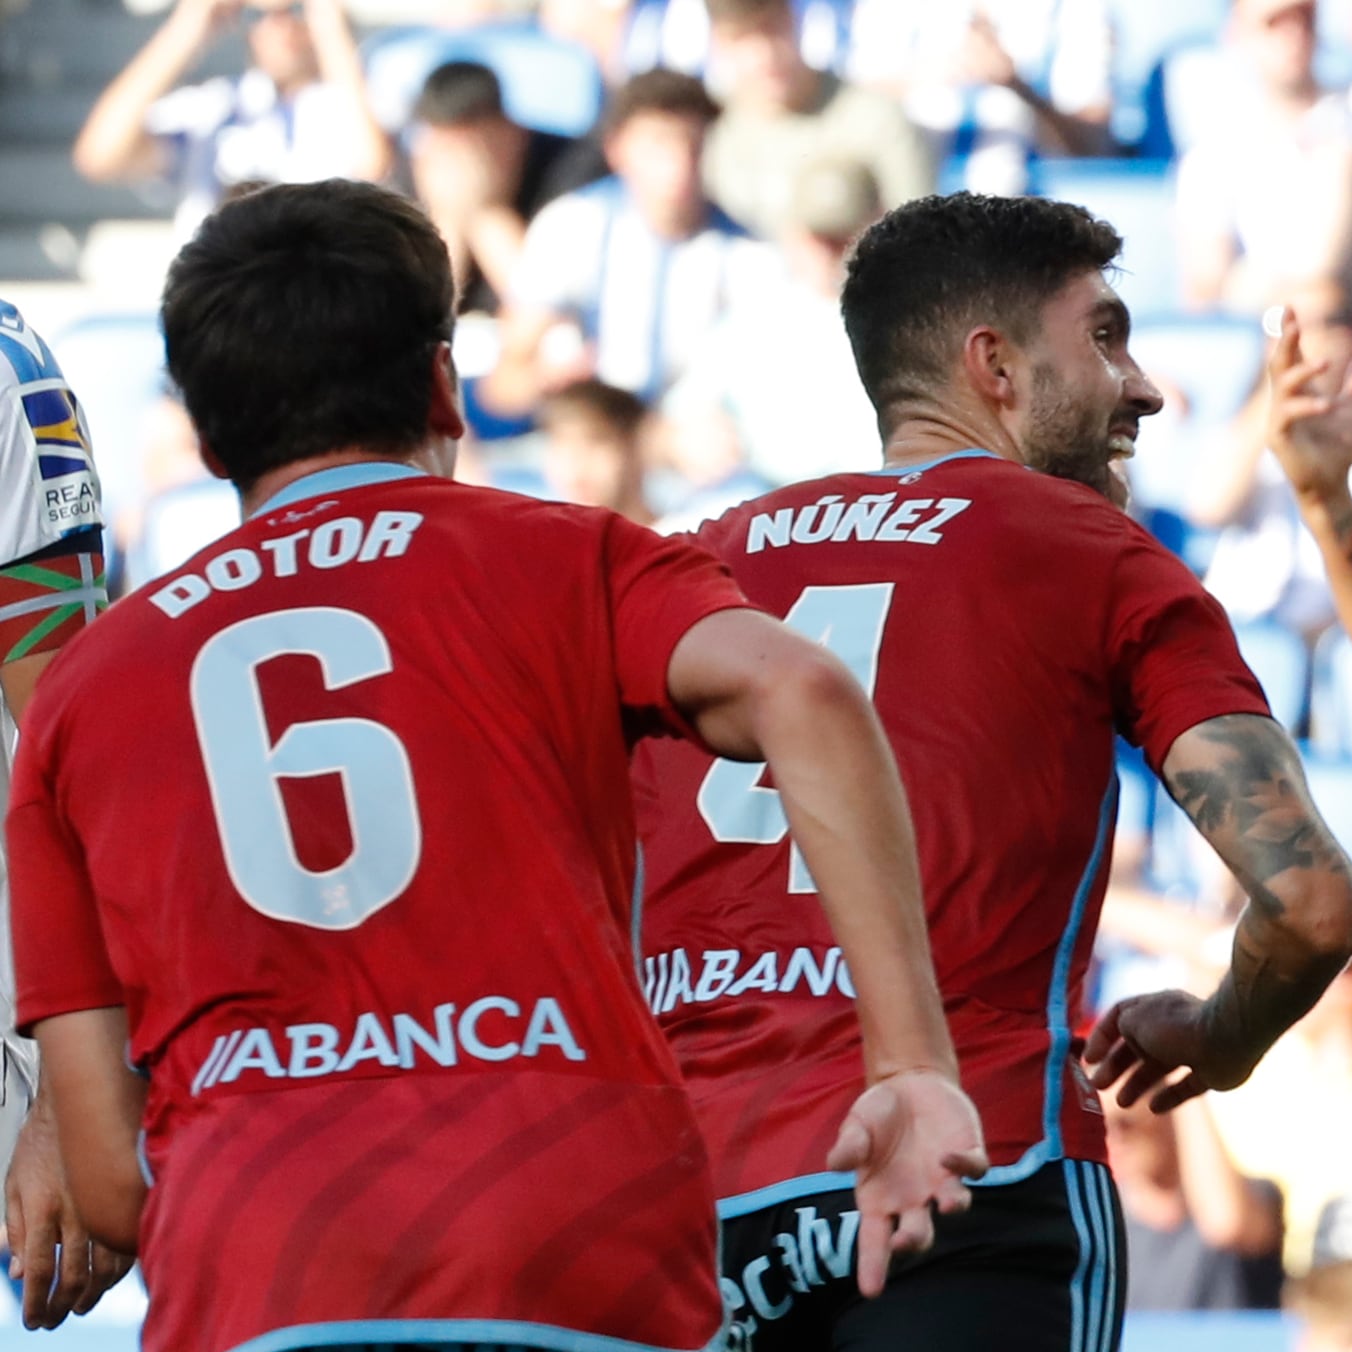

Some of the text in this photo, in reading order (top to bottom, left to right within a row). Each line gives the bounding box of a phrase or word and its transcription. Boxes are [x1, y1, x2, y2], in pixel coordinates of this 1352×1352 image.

[44, 481, 95, 507] REA
[746, 492, 972, 553] NÚÑEZ
[149, 511, 424, 618] DOTOR
[191, 606, 421, 930] 6
[661, 947, 857, 1013] ABAN
